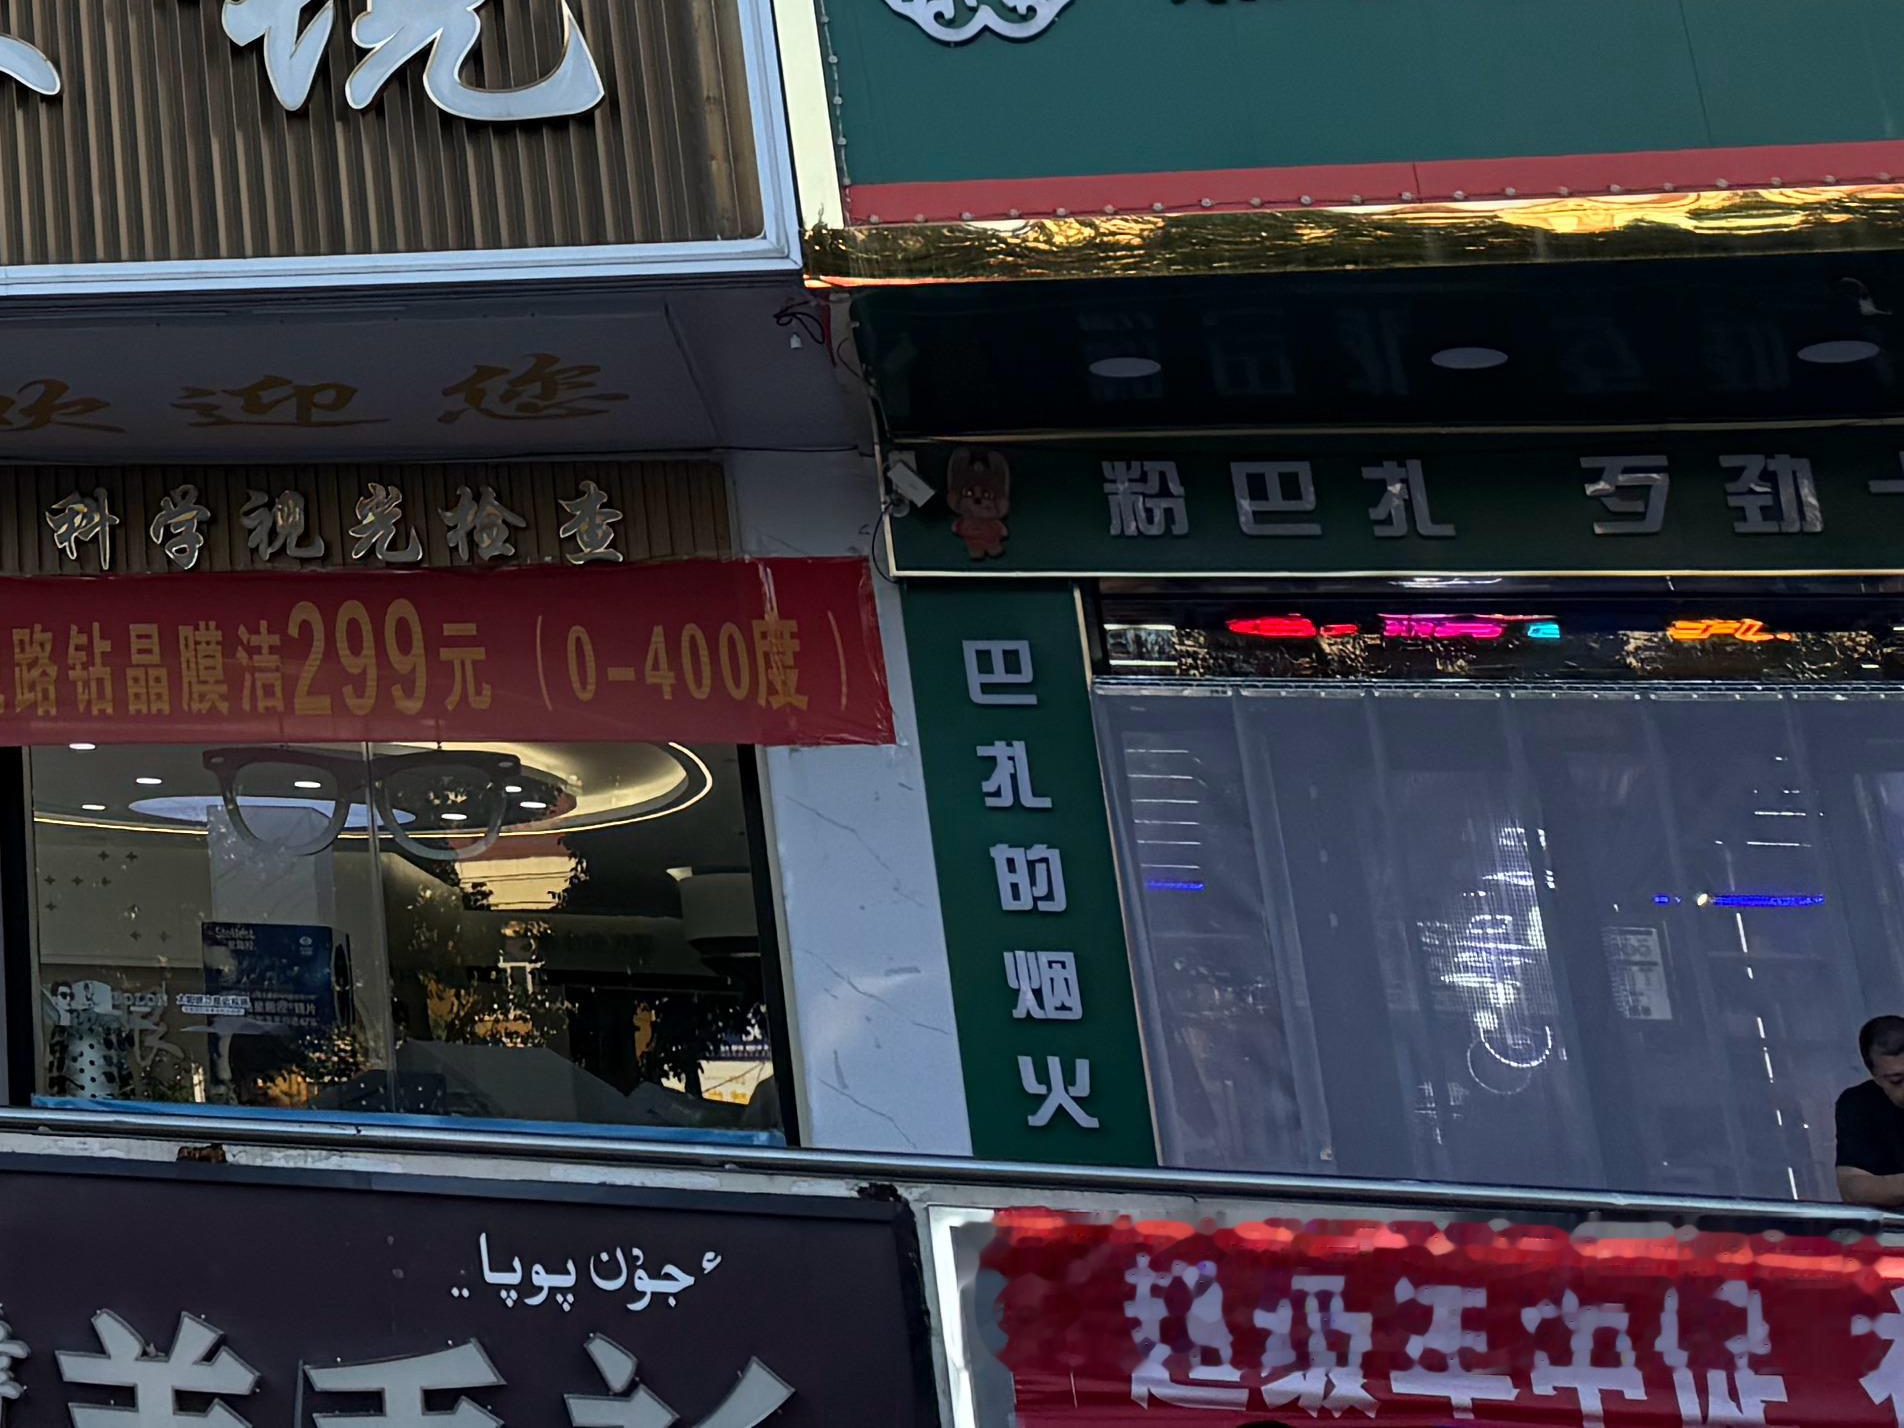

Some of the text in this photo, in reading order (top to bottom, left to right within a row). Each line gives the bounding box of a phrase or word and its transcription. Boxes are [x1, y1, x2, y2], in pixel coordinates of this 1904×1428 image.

[43, 480, 629, 572] 科学视光检查
[1102, 456, 1456, 539] 粉巴扎
[962, 639, 1099, 1130] 巴扎的烟火
